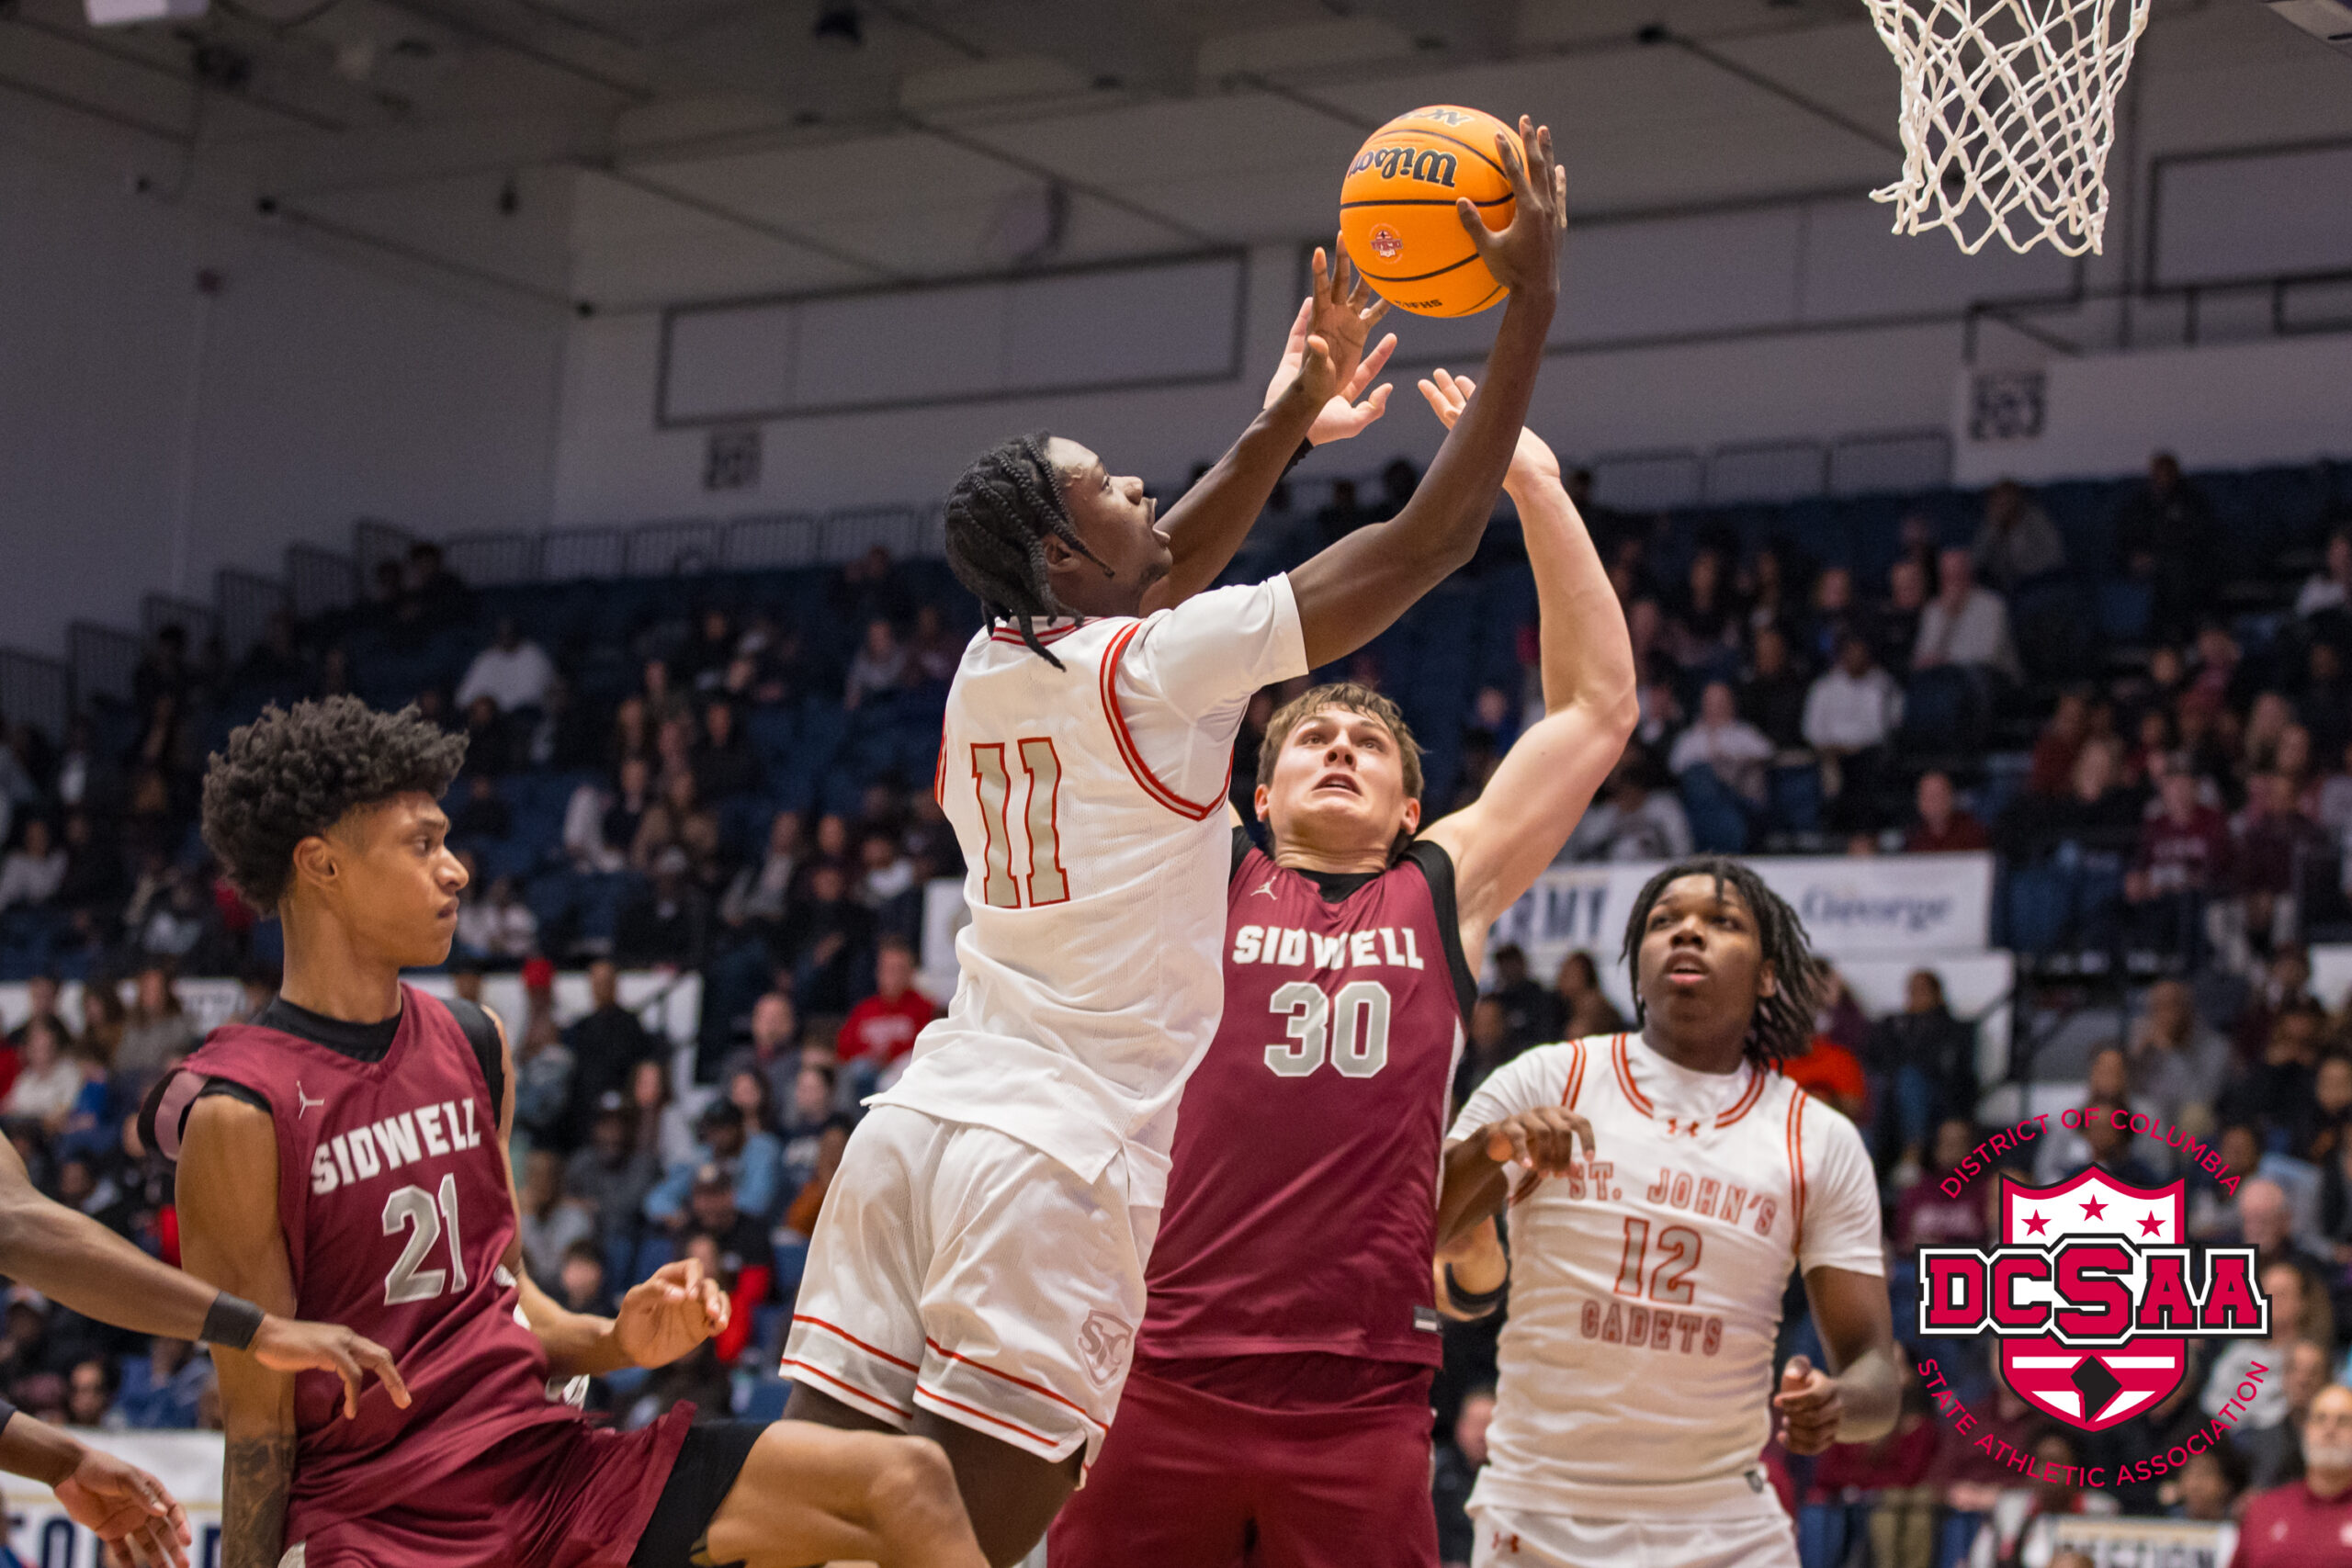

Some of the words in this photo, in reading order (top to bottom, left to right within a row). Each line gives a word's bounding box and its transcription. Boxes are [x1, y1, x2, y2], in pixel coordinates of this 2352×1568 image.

[1347, 146, 1456, 188] Wilson
[970, 737, 1070, 909] 11
[1232, 925, 1424, 970] SIDWELL
[1264, 981, 1391, 1078] 30
[311, 1098, 481, 1195] SIDWELL
[381, 1172, 467, 1306] 21
[1647, 1168, 1777, 1236] JOHN'S
[1614, 1215, 1702, 1304] 12
[1580, 1300, 1724, 1356] CADETS
